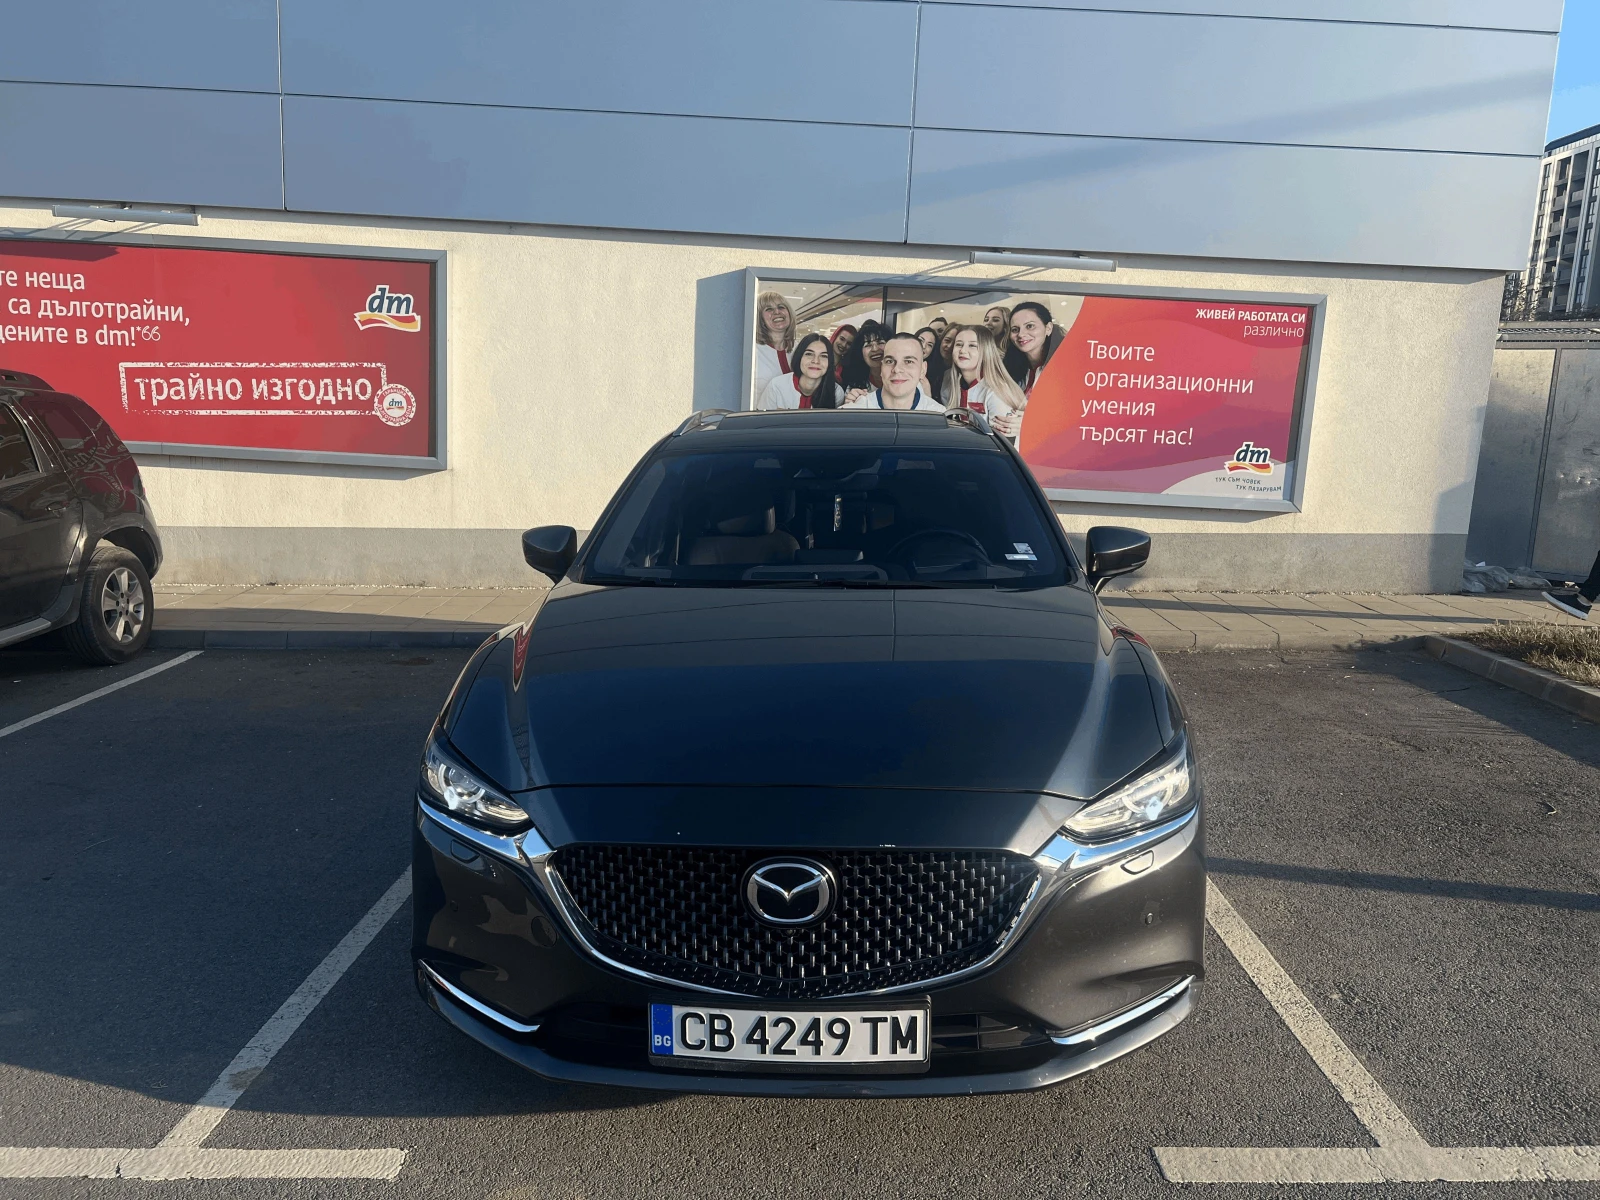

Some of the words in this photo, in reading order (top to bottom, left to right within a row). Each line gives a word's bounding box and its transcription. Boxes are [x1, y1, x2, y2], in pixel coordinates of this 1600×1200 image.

[25, 271, 86, 293] неща
[367, 286, 413, 315] dm
[8, 297, 31, 315] са
[37, 298, 191, 326] дълготрайни,
[1195, 307, 1236, 320] ЖИВЕЙ
[1238, 310, 1289, 323] РАБОТАТА
[1291, 313, 1306, 323] СИ
[75, 328, 88, 344] в
[1243, 325, 1305, 338] различно
[1087, 340, 1155, 361] Твоите
[133, 372, 244, 406] трайно
[251, 377, 373, 405] изгодно
[1084, 371, 1254, 394] организационни
[388, 398, 403, 407] dm
[1081, 399, 1155, 417] умения
[1079, 426, 1147, 446] търсят
[1153, 427, 1194, 446] нас!
[1235, 443, 1269, 464] dm
[653, 1034, 672, 1047] BG
[679, 1011, 735, 1053] CB
[746, 1015, 852, 1056] 4249
[860, 1016, 918, 1055] TM
